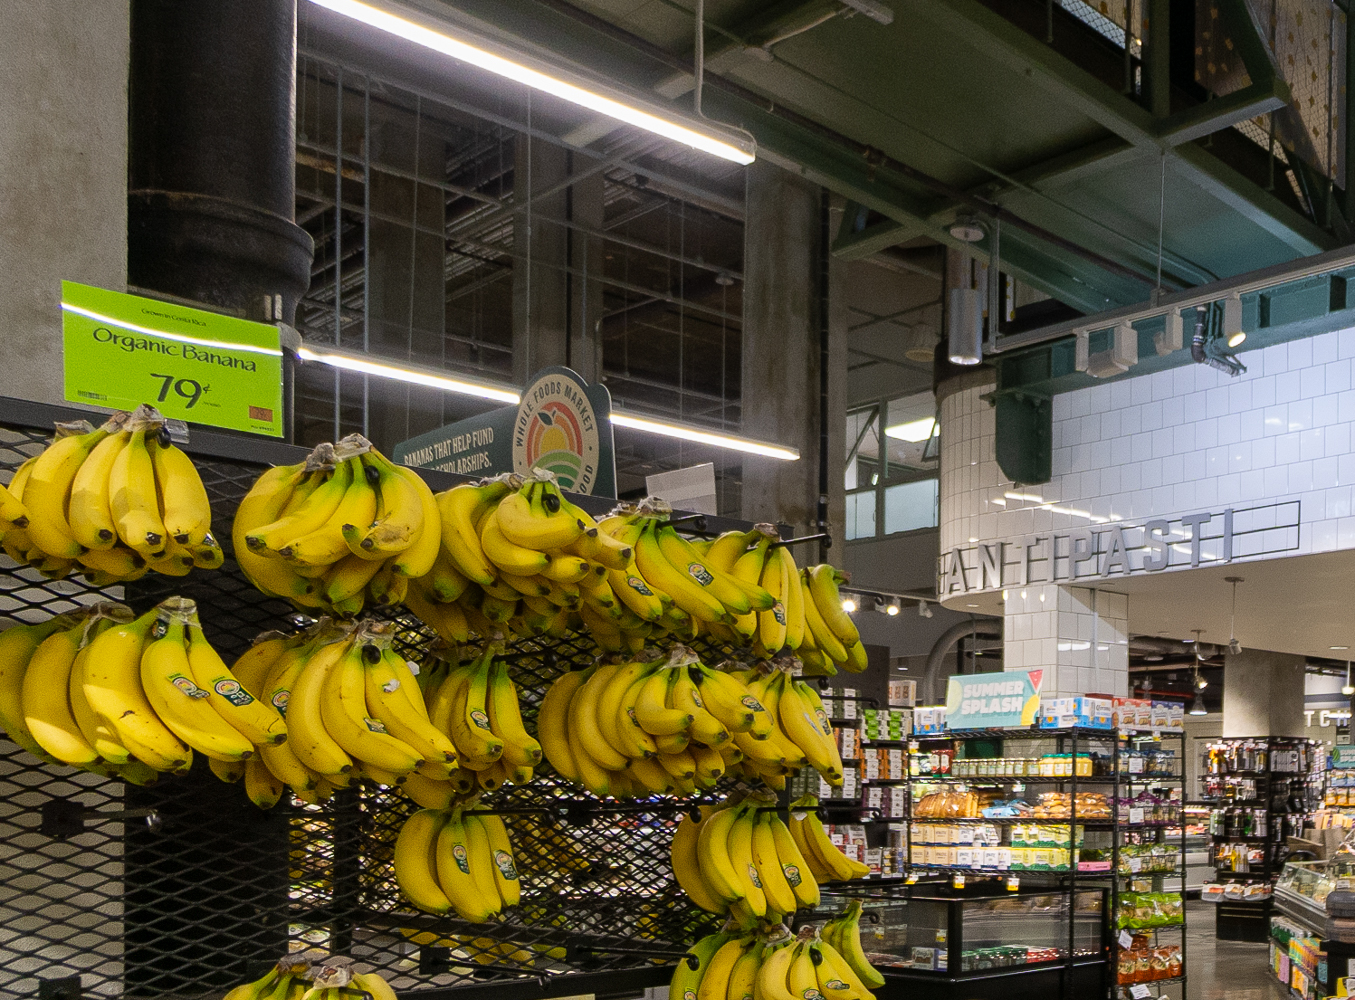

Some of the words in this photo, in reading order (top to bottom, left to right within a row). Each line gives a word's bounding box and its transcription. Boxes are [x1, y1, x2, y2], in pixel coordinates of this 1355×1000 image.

[93, 327, 179, 357] Organic
[182, 344, 257, 373] Banana
[516, 401, 534, 447] WHOLE
[533, 381, 562, 404] FOODS
[563, 384, 594, 432] MARKET
[434, 439, 453, 460] THAT
[452, 433, 472, 454] HELP
[472, 427, 494, 448] FUND
[576, 465, 593, 494] OOD
[946, 508, 1234, 594] ANTIPASTI
[961, 696, 1024, 715] SPLASH
[962, 680, 1025, 699] SUMMER
